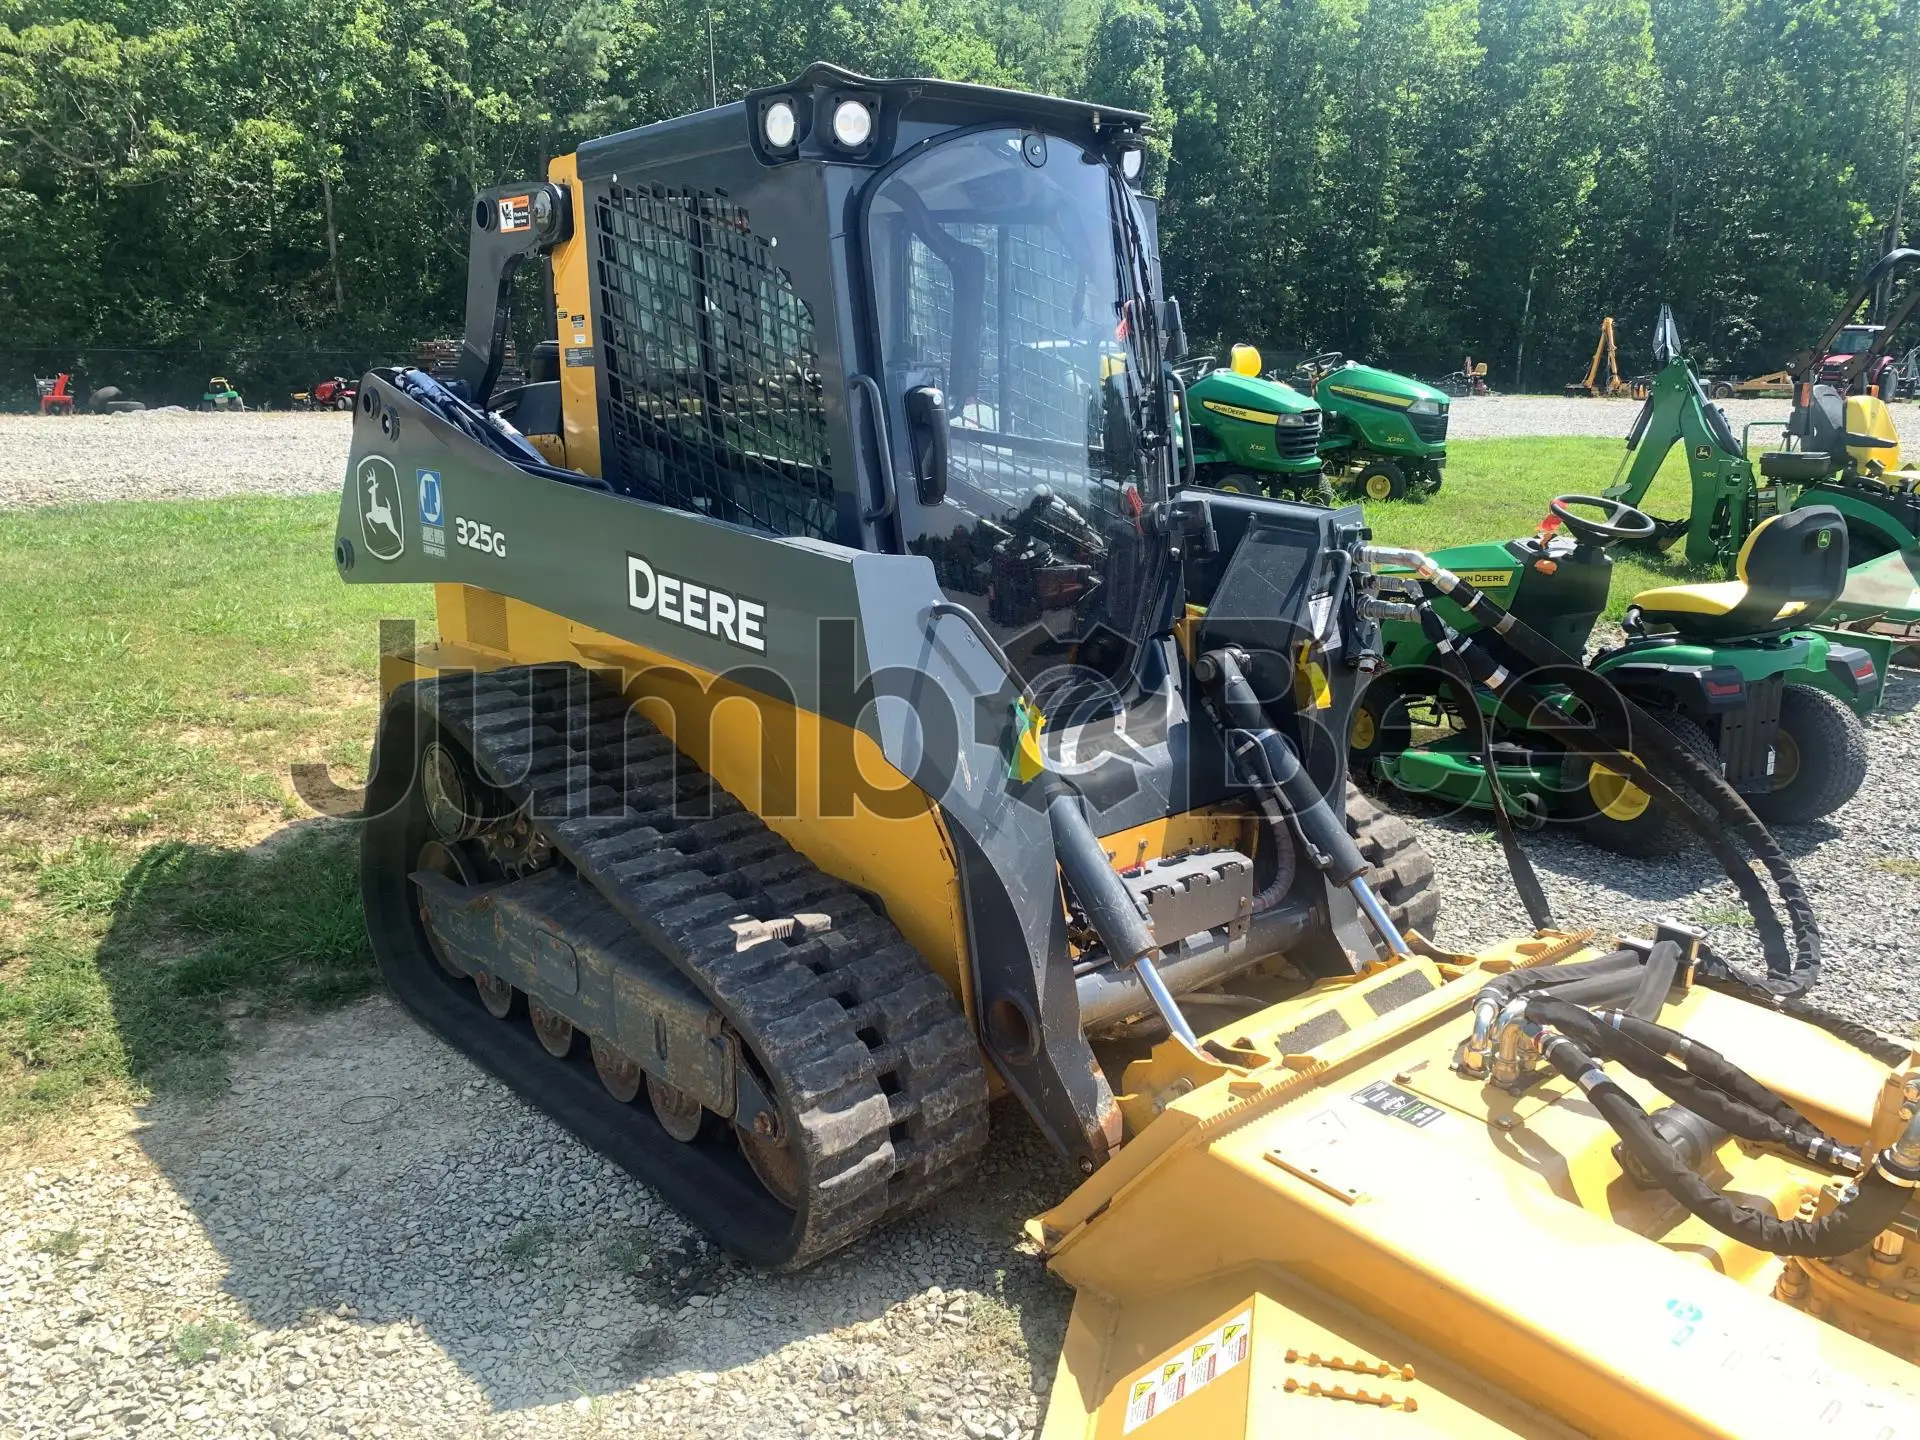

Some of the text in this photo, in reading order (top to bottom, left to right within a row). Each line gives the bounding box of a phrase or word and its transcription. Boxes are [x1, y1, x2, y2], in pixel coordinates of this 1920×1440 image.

[1212, 404, 1248, 416] JOHN DEERE
[455, 515, 506, 558] 325G
[1474, 574, 1505, 582] DEERE
[627, 555, 767, 653] DEERE
